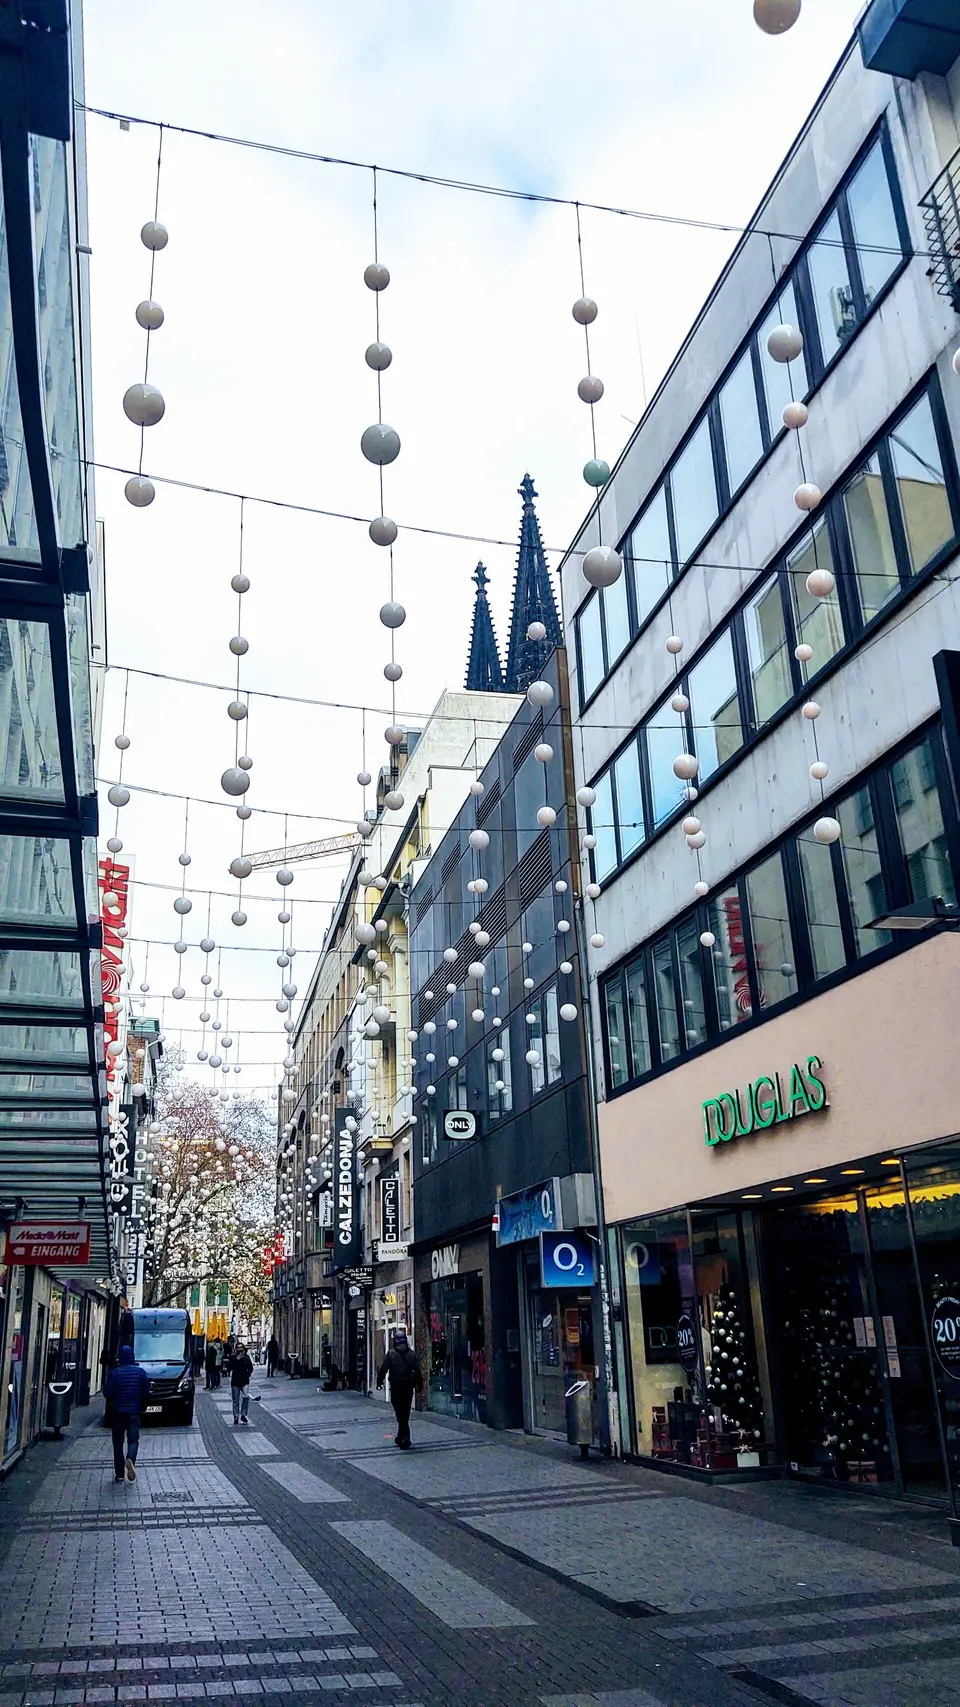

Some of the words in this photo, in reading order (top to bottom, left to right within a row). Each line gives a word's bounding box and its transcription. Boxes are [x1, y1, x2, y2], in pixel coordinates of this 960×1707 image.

[702, 1055, 828, 1147] DOUGLAS
[446, 1120, 474, 1131] ONLY
[131, 1131, 148, 1218] HOTEL
[339, 1128, 353, 1245] CALZEDONIA
[541, 1190, 553, 1223] O2
[31, 1245, 80, 1256] EINGANG
[431, 1244, 459, 1279] ONLY
[553, 1243, 585, 1276] O2
[678, 1329, 695, 1347] 20%
